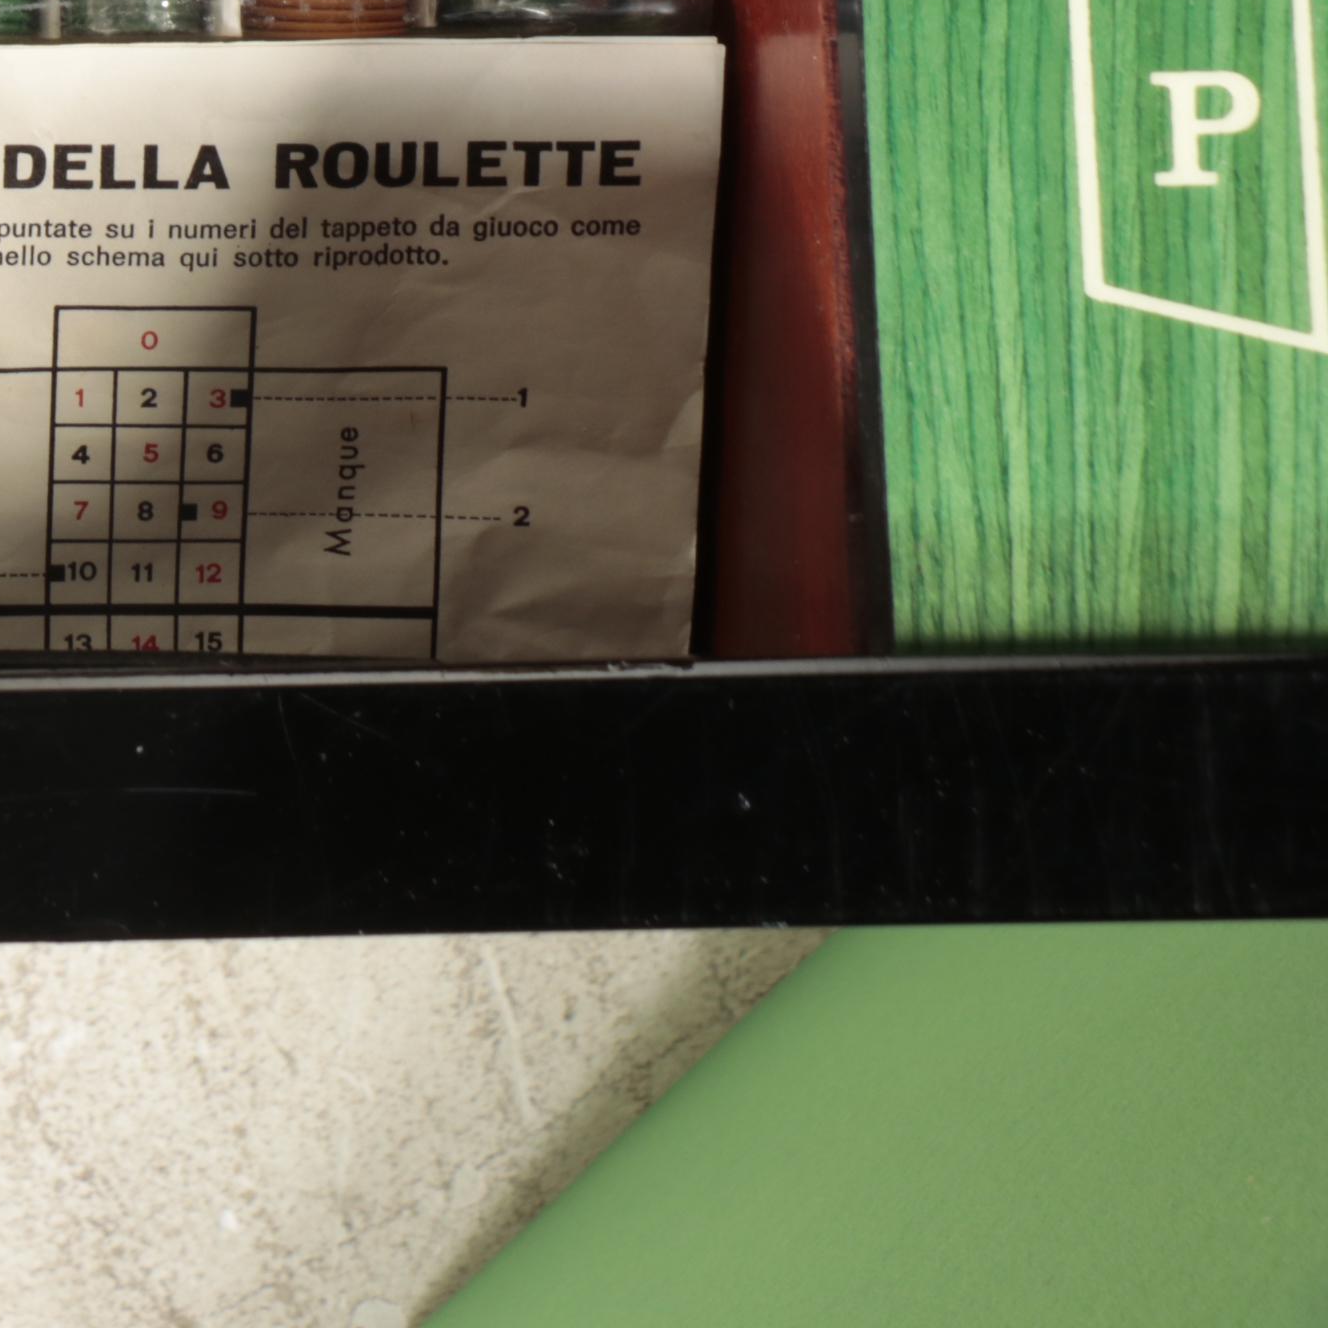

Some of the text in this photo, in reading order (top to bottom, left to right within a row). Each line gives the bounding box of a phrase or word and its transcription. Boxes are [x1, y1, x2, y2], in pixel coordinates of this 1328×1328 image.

[1149, 69, 1260, 187] P
[3, 144, 231, 191] DELLA
[275, 140, 642, 190] ROULETTE
[105, 223, 135, 239] su
[169, 218, 256, 239] numeri
[269, 216, 308, 240] del
[320, 217, 417, 243] tappeto
[429, 213, 460, 238] da
[472, 215, 559, 242] giuoco
[570, 219, 641, 237] come
[66, 246, 166, 268] schema
[179, 247, 218, 272] qui
[233, 245, 300, 268] sotto
[313, 245, 449, 269] riprodotto.
[140, 329, 161, 352] 0
[140, 387, 158, 409] 2
[207, 388, 225, 410] 3
[71, 441, 225, 465] 4 5 6
[323, 426, 366, 556] Manque
[74, 499, 230, 522] 7 8 9
[512, 505, 531, 528] 2
[67, 561, 225, 585] 10 11 12
[64, 632, 222, 652] 13 14 15
